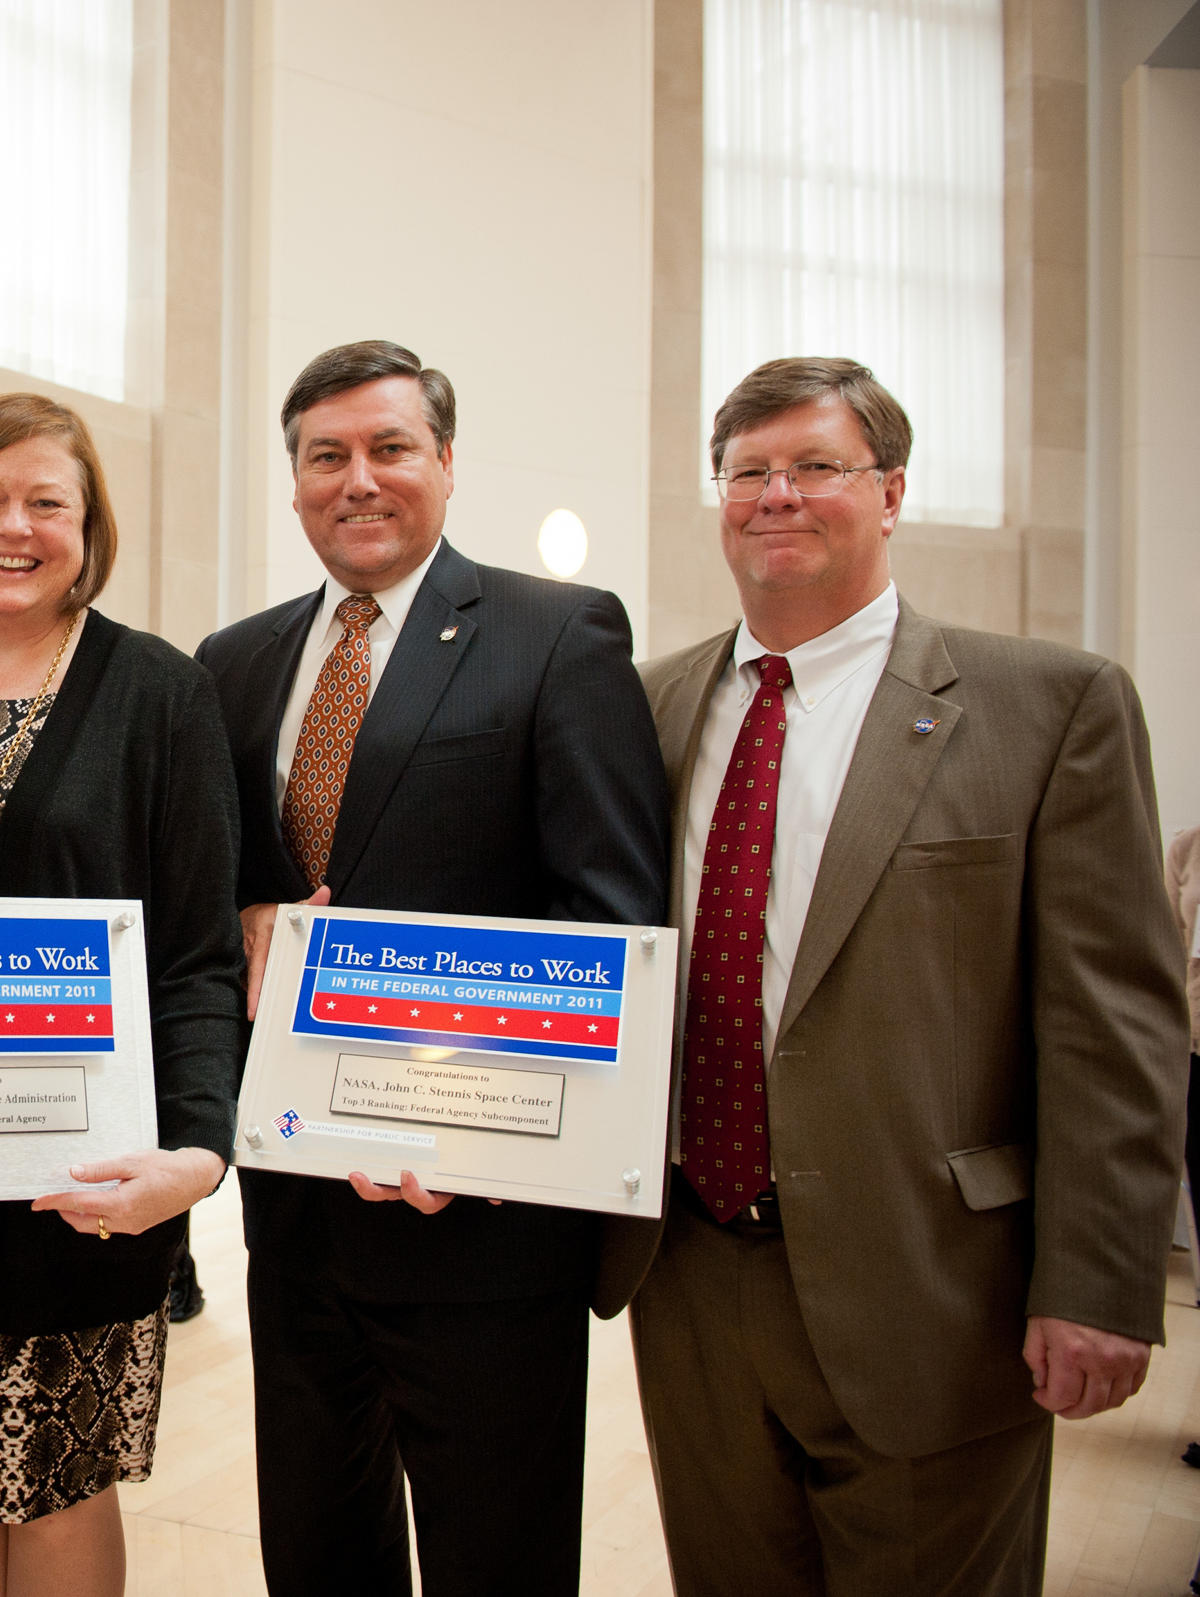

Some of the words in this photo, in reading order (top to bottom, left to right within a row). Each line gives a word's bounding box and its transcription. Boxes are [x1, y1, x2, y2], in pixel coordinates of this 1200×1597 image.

[8, 953, 32, 970] to
[35, 946, 100, 971] Work
[331, 944, 374, 967] The
[379, 947, 428, 971] Best
[432, 951, 503, 976] Places
[510, 961, 534, 979] to
[540, 959, 611, 985] Work
[64, 985, 97, 998] 2011
[331, 976, 348, 989] IN
[351, 977, 380, 991] THE
[383, 980, 449, 997] FEDERAL
[454, 986, 563, 1006] GOVERNMENT
[567, 995, 603, 1010] 2011
[406, 1067, 479, 1081] Congratulations
[480, 1075, 490, 1083] to
[4, 1092, 77, 1104] Administration
[382, 1082, 410, 1093] John
[413, 1084, 426, 1095] C.
[428, 1086, 472, 1100] Stennis
[474, 1090, 509, 1103] Space
[511, 1094, 553, 1108] Center
[16, 1114, 47, 1124] Agency
[342, 1096, 358, 1107] Top
[367, 1099, 408, 1112] Ranking:
[410, 1103, 445, 1114] Federal
[446, 1108, 479, 1120] Agency
[480, 1111, 549, 1126] Subcomponent
[308, 1124, 356, 1136] PARTNERSHIP
[357, 1129, 372, 1137] FOR
[374, 1131, 399, 1140] PUBLIC
[402, 1135, 433, 1145] SERVICE
